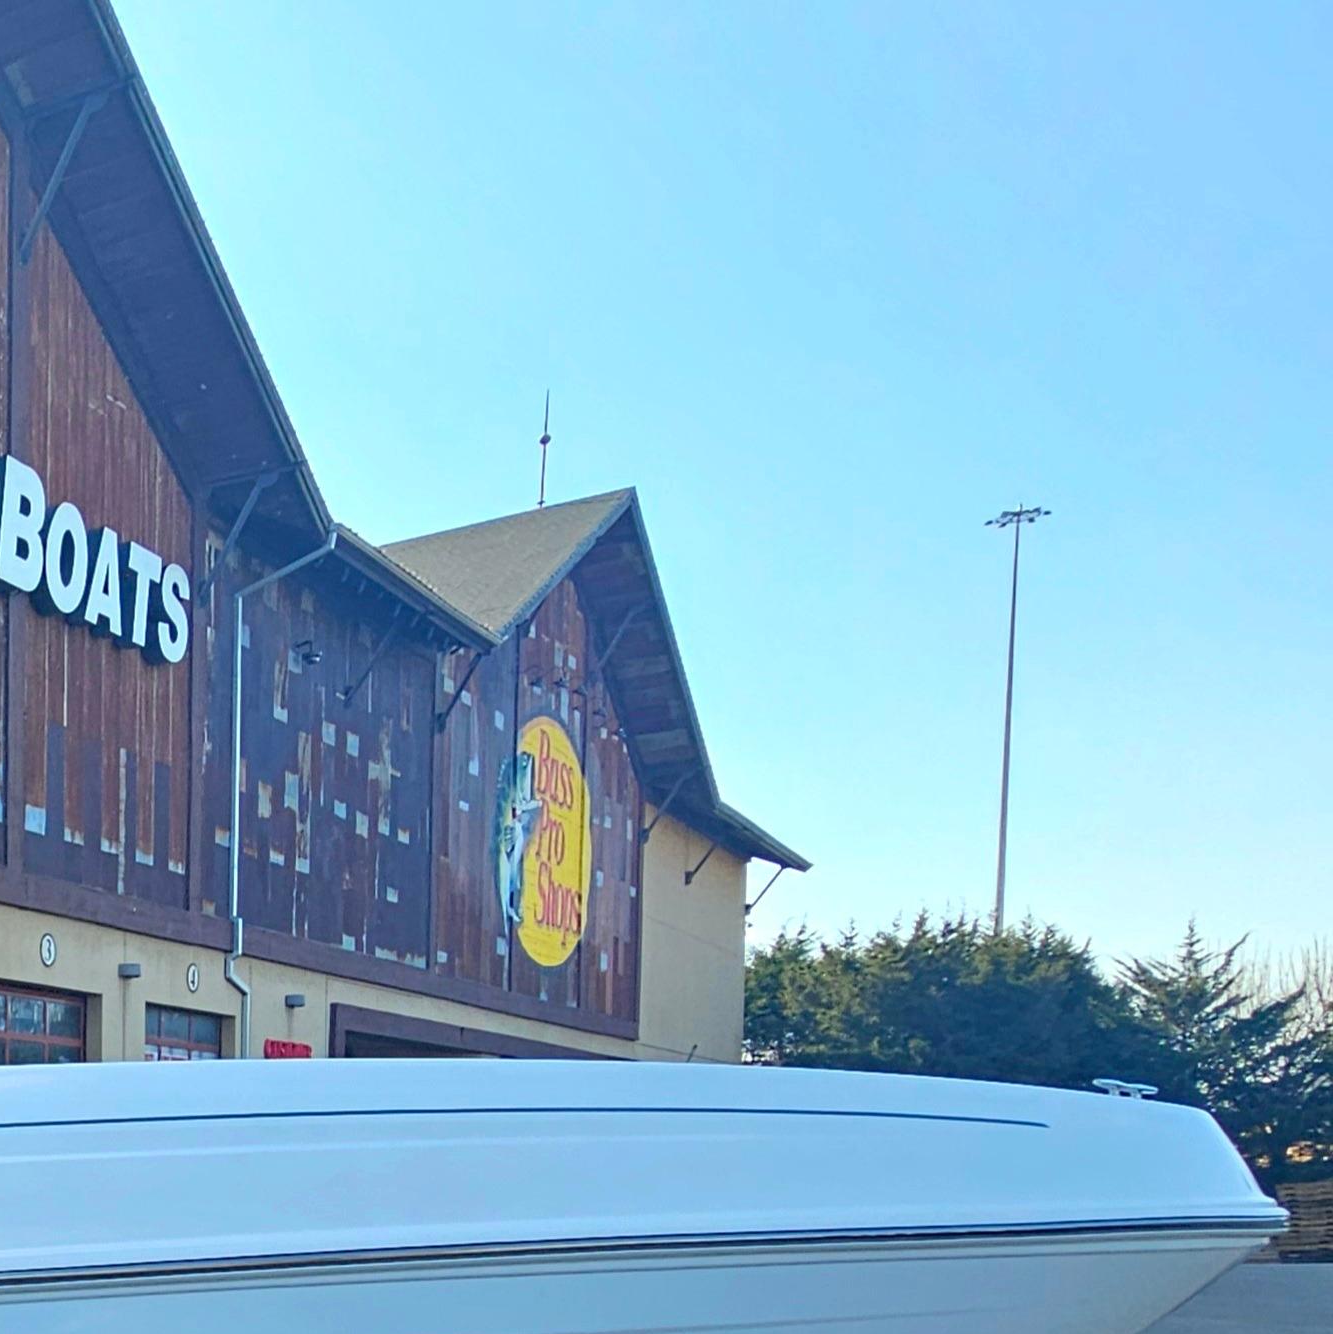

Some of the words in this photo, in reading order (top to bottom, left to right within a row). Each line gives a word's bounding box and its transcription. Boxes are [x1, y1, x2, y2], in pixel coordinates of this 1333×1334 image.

[536, 727, 575, 812] Bass
[534, 797, 566, 866] Pro
[533, 861, 581, 950] Shops
